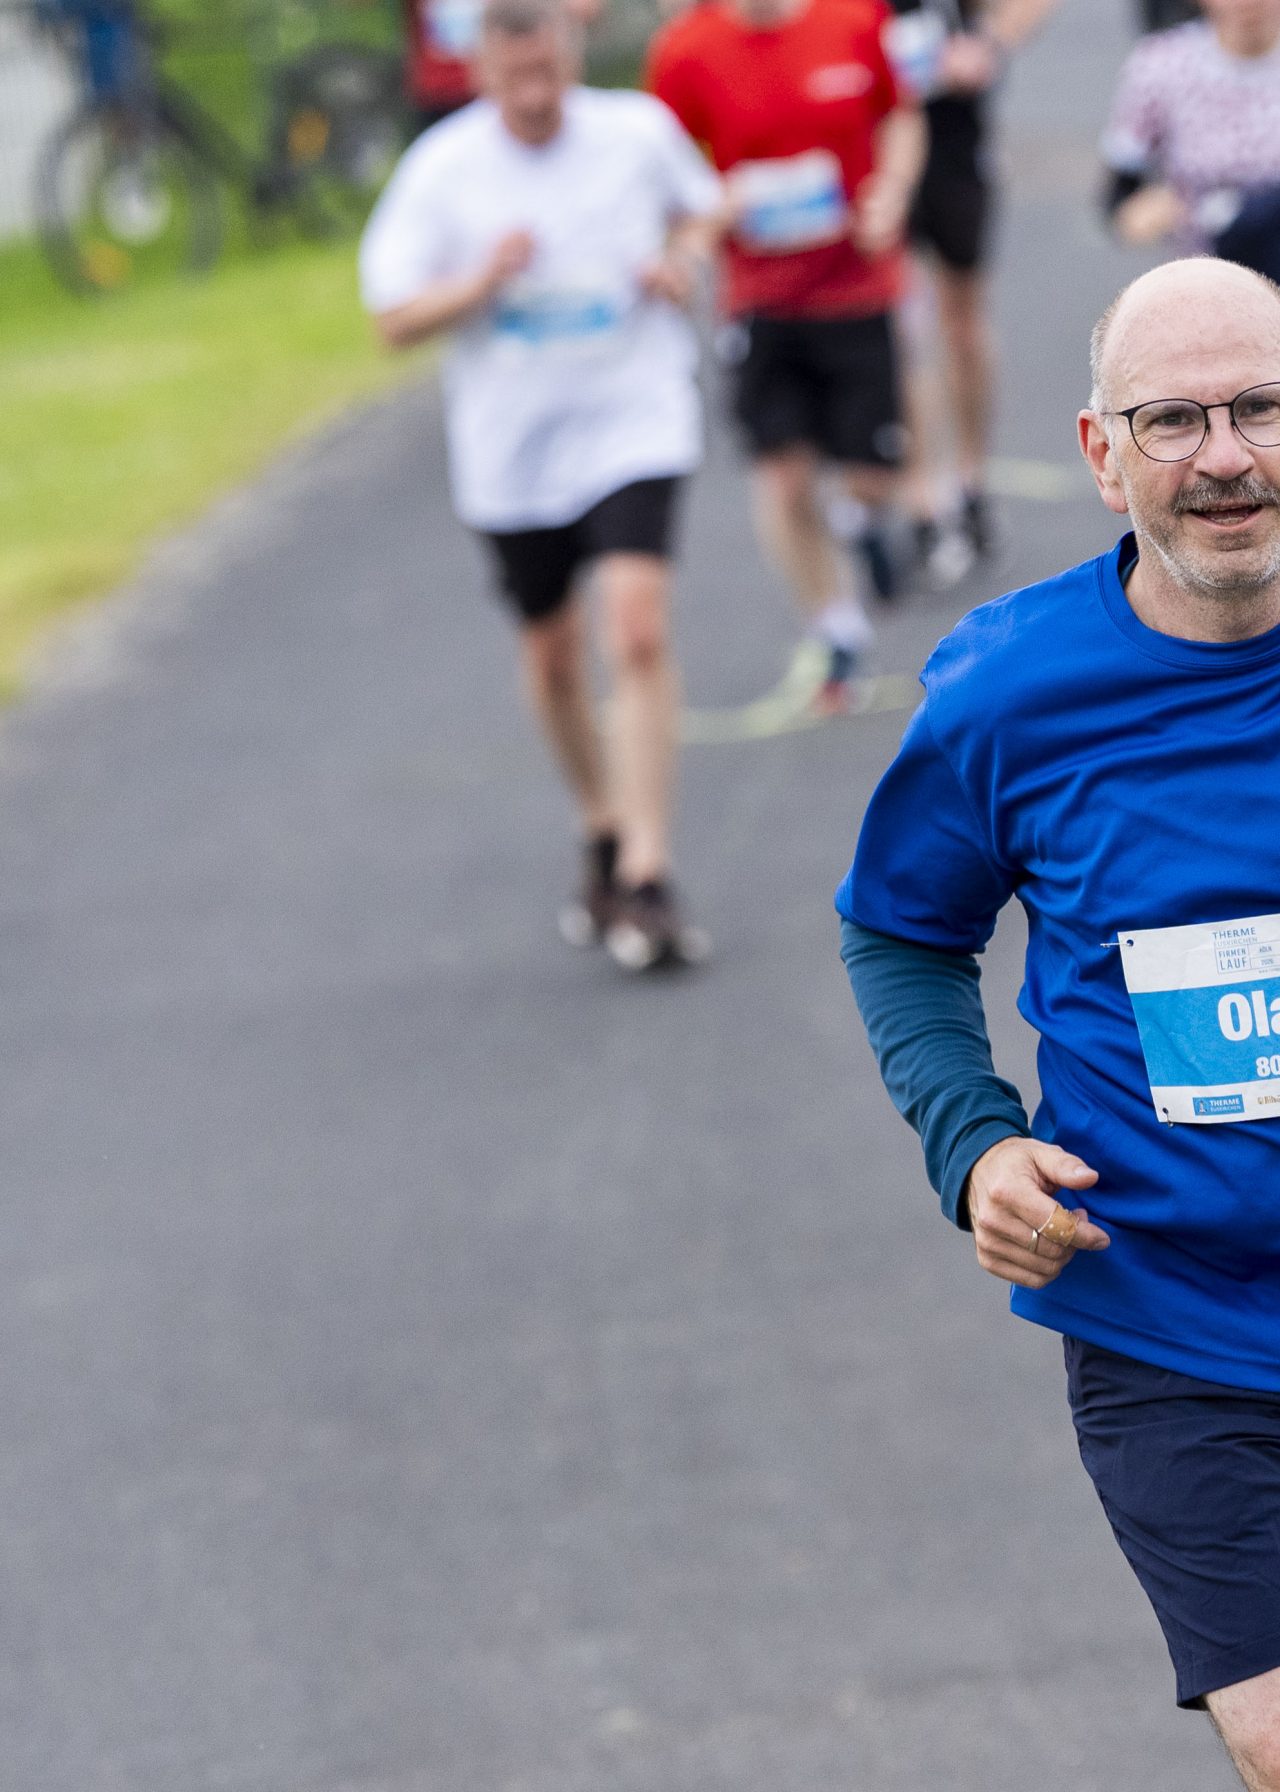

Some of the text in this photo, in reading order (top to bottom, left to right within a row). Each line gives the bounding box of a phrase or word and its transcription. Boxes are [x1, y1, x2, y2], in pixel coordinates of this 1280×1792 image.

[1212, 926, 1256, 940] THERME
[1218, 948, 1246, 958] FIRMEN
[1220, 957, 1247, 970] LAUF
[1210, 1097, 1240, 1107] THERME
